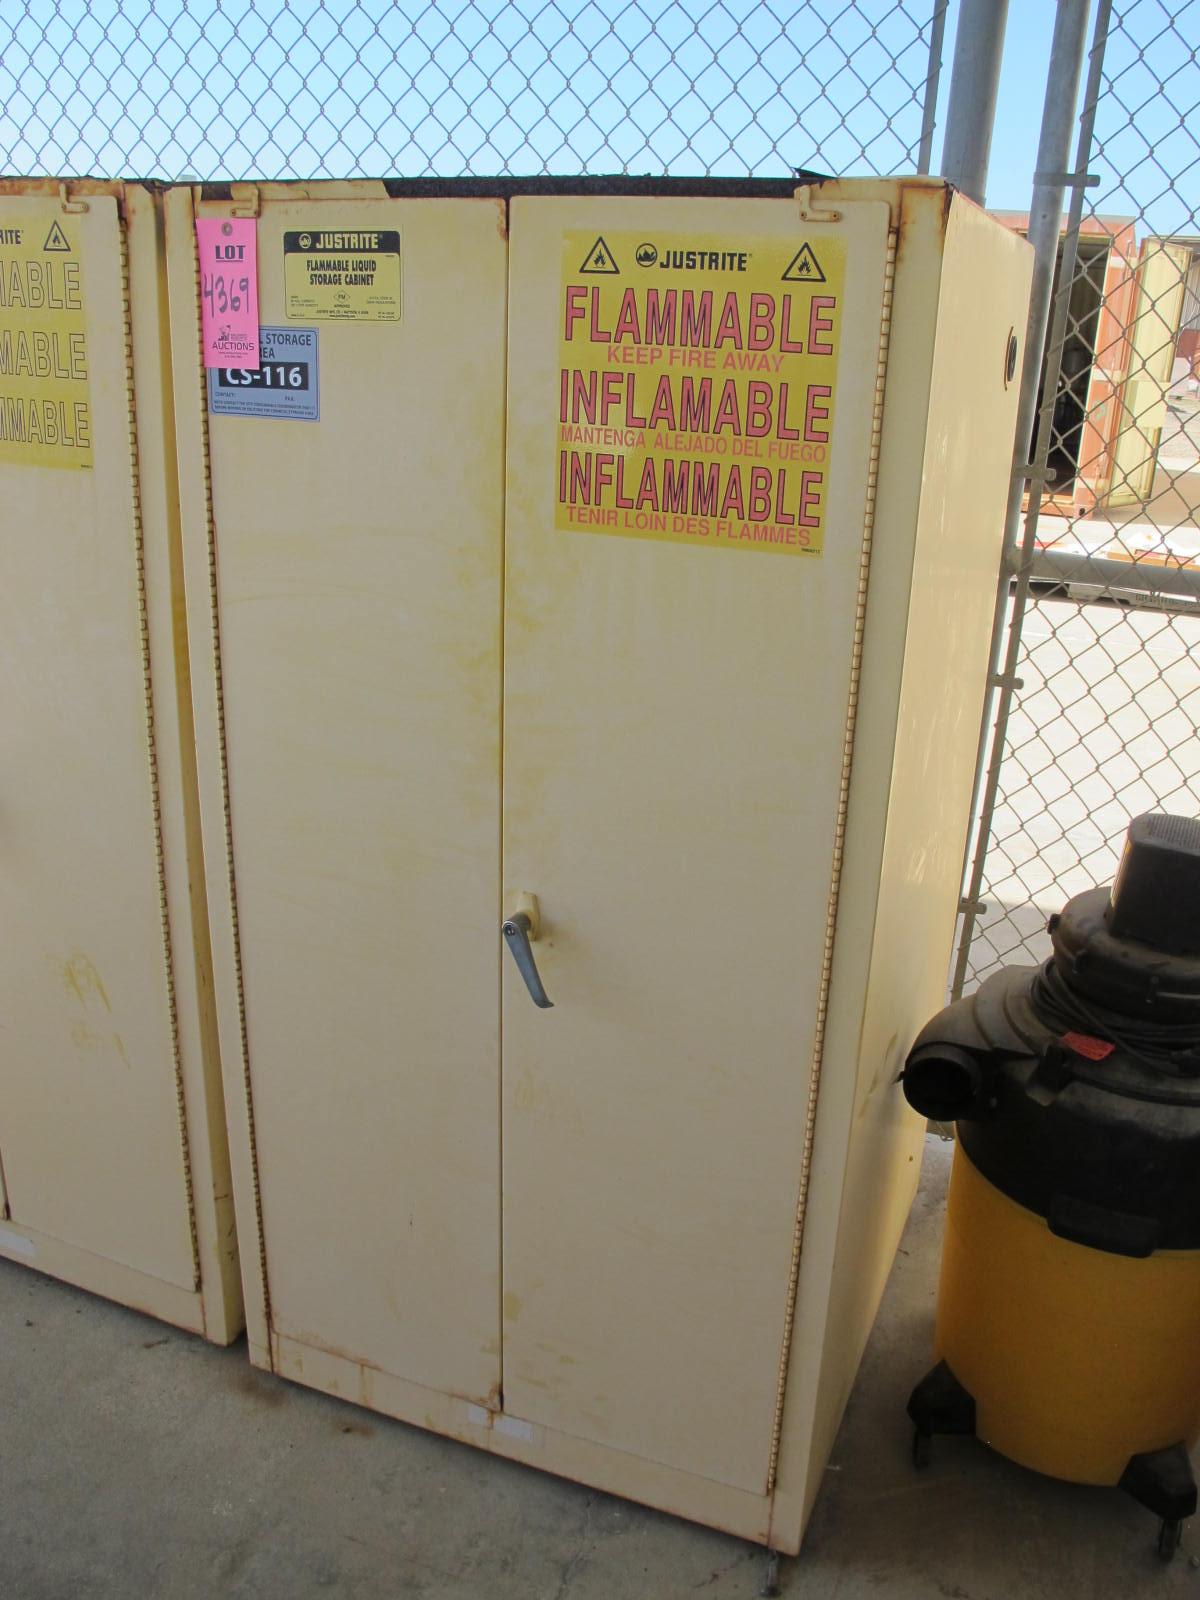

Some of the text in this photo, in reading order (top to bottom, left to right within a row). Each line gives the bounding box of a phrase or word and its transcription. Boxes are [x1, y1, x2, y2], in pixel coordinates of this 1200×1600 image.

[316, 233, 379, 249] JUSTRITE
[215, 245, 246, 260] LOT
[660, 250, 748, 272] JUSTRITE
[307, 259, 376, 272] FLAMMABLE LIQUID
[310, 273, 374, 286] STORAGE CABINET
[203, 273, 250, 318] 4369
[565, 285, 837, 356] FLAMMABLE
[212, 341, 255, 351] AUCTIONS
[265, 333, 312, 346] STORAGE
[607, 345, 785, 374] KEEP FIRE AWAY
[225, 366, 302, 387] CS-116
[560, 369, 833, 443] INFLAMABLE
[561, 425, 826, 464] MANTENGA ALEJADO DEL FUEGO
[559, 450, 824, 528] INFLAMMABLE
[566, 505, 811, 547] TENIR LOIN DES FLAMMES
